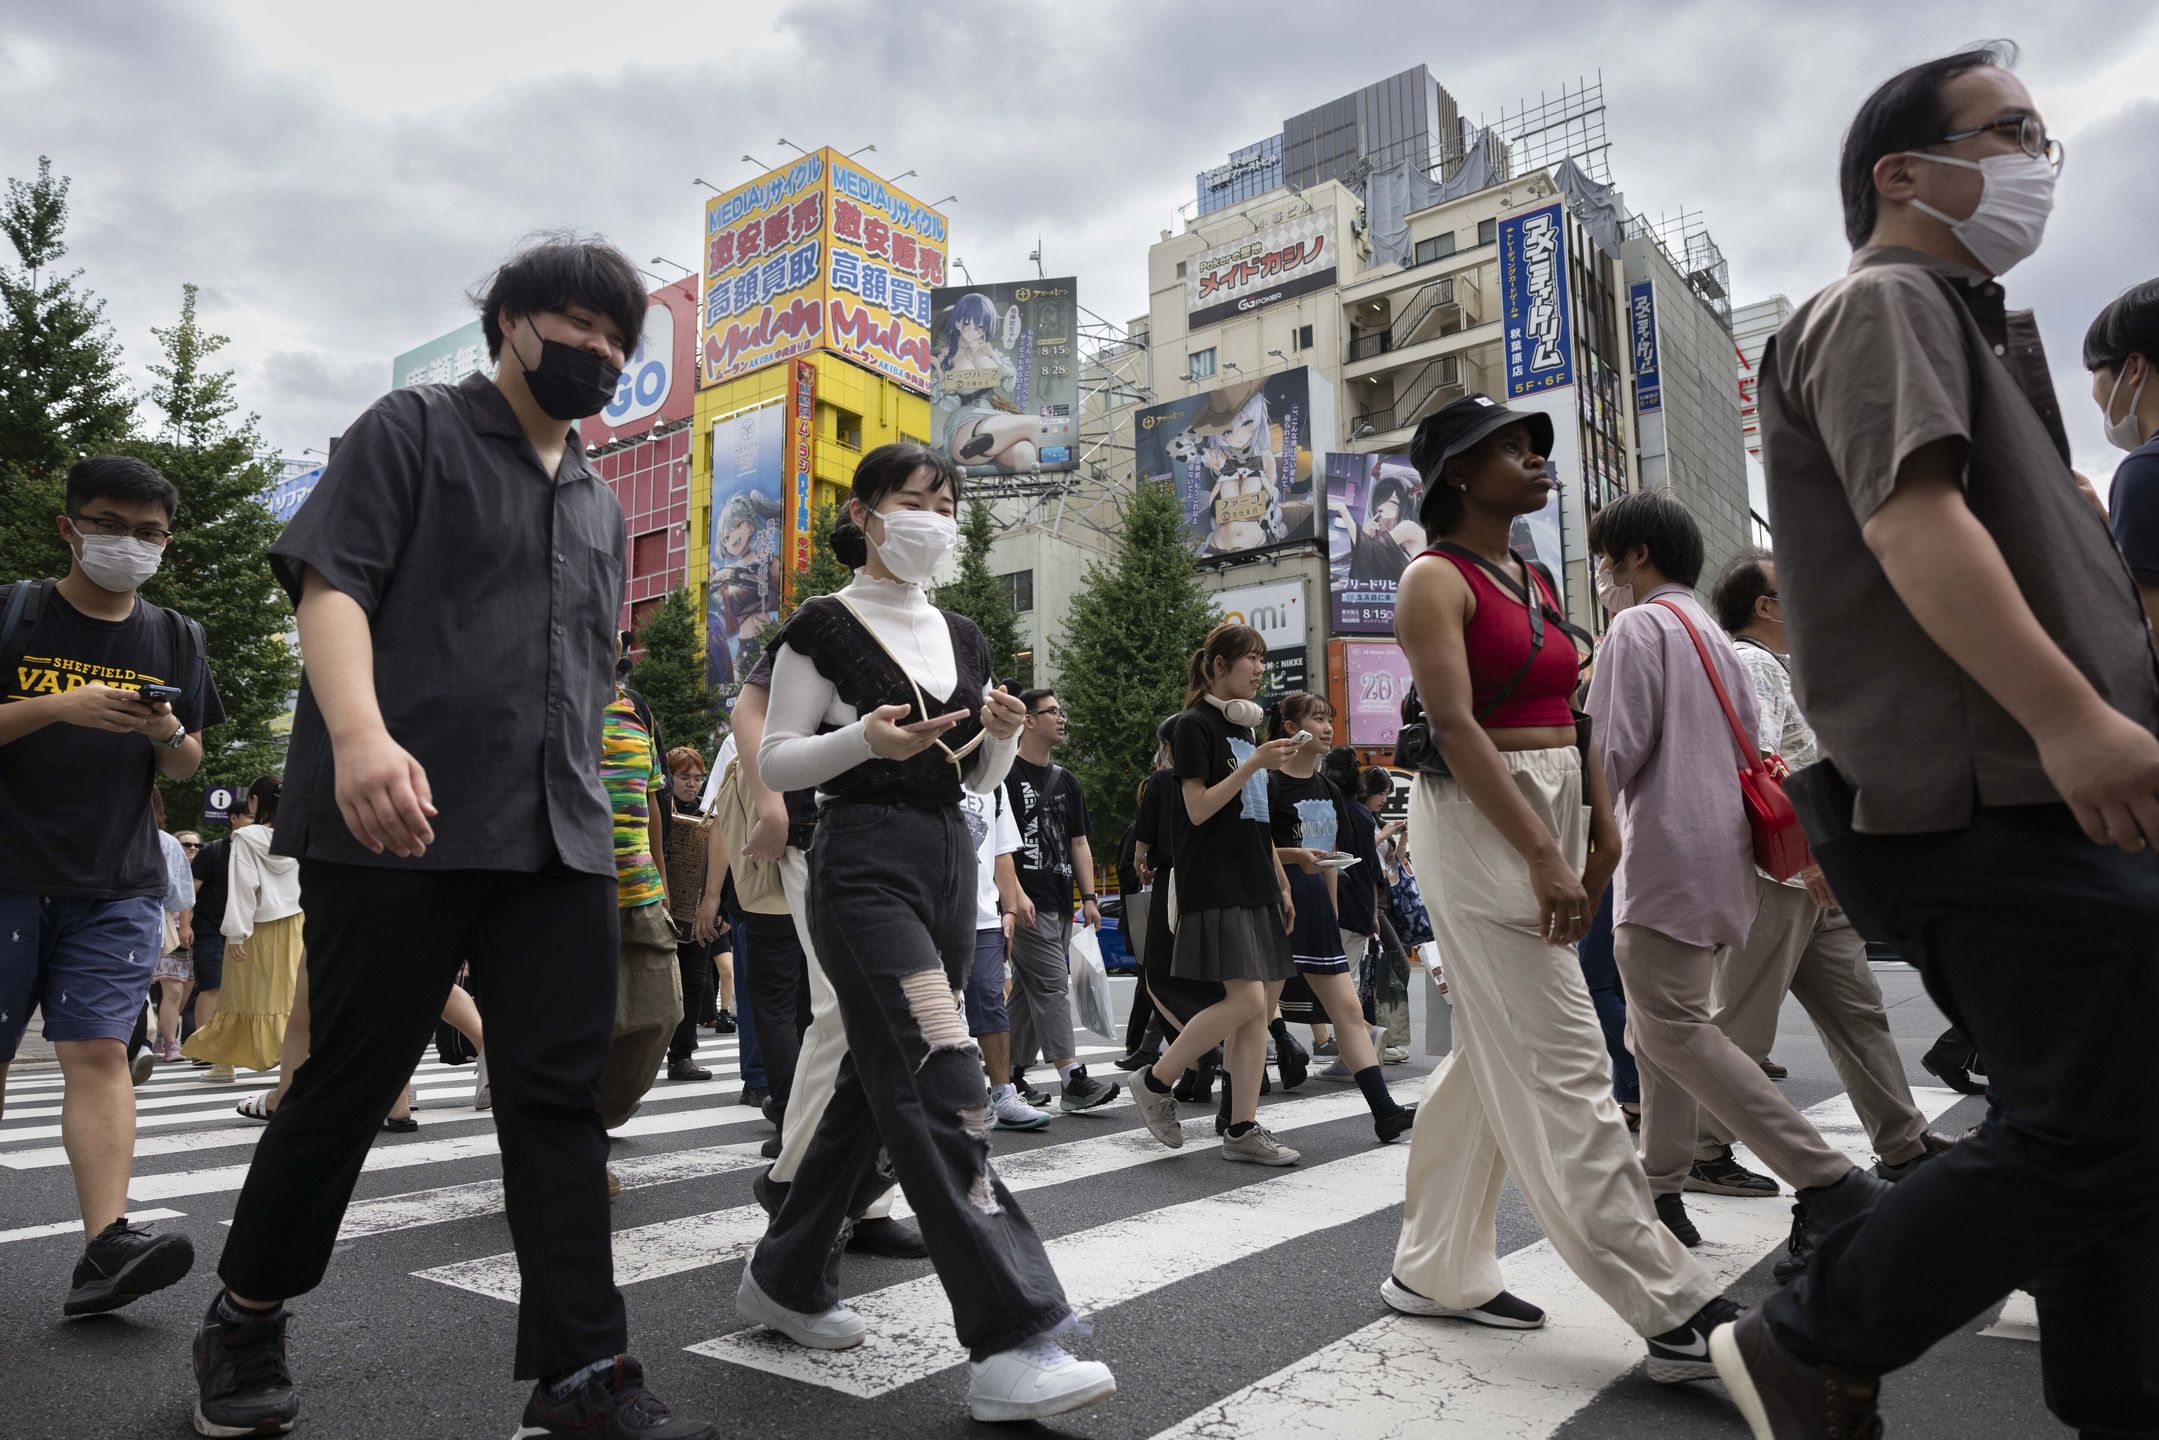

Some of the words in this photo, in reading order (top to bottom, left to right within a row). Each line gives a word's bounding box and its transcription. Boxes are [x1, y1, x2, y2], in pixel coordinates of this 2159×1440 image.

[709, 155, 823, 234] MEDIAリサイクル
[831, 162, 945, 241] MEDIAリサイクル
[709, 191, 822, 278] 激安販売
[832, 198, 945, 286] 激安販売
[706, 240, 820, 328] 高額買取
[1199, 235, 1324, 299] メイドカジノ
[704, 298, 822, 380] Mulan
[716, 362, 748, 380] ムーラン
[748, 353, 774, 369] AKIBA
[842, 343, 878, 365] ムーラン
[878, 360, 904, 378] AKIBA
[1510, 328, 1523, 377] 秋葉原店
[1220, 492, 1260, 511] ファーゴ
[1340, 579, 1397, 590] フリードリヒ
[53, 657, 136, 680] SHEFFIELD
[1361, 672, 1392, 701] 20
